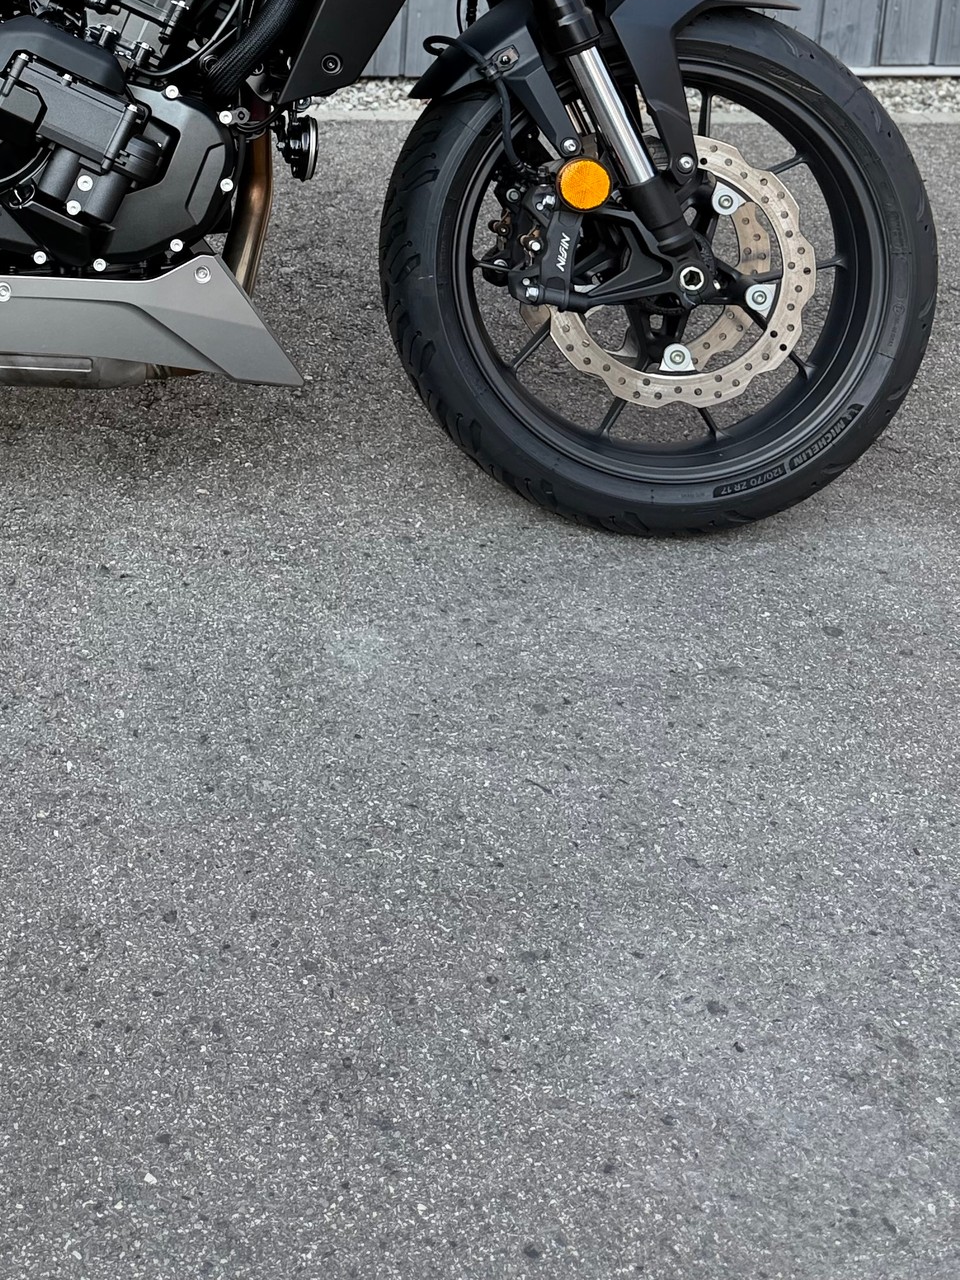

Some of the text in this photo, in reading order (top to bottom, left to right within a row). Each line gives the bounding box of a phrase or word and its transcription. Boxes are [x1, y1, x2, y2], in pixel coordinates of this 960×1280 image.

[721, 420, 846, 494] MICHELIN 120/70 ZR 17
